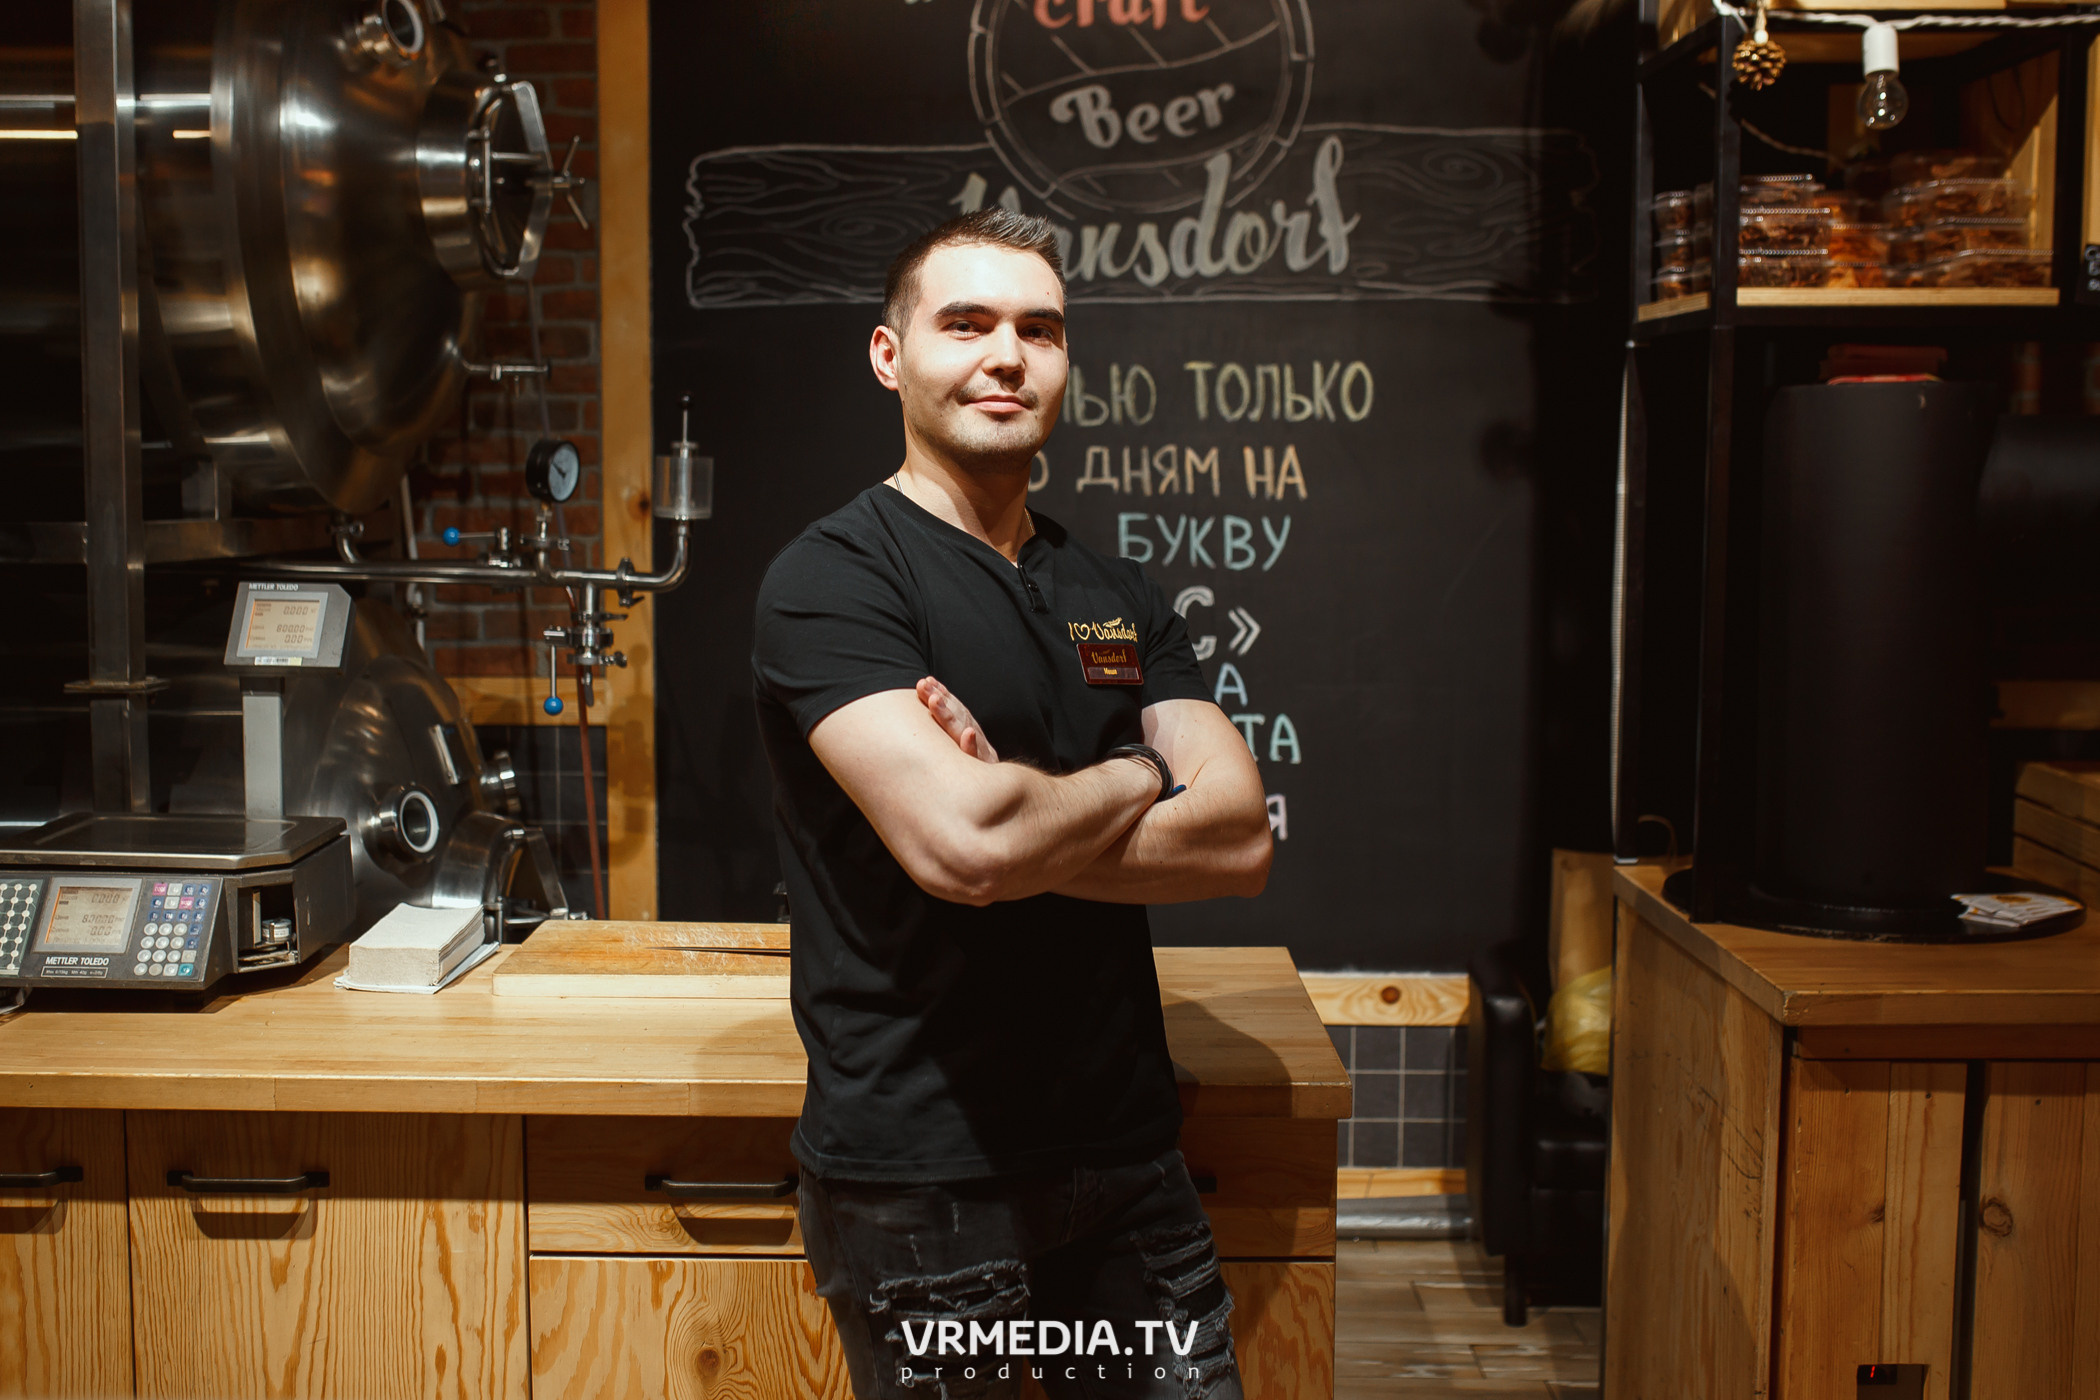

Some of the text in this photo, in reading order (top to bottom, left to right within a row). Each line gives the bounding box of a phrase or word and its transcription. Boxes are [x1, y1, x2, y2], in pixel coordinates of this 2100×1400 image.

[1050, 82, 1235, 149] Beer
[1184, 361, 1374, 421] ТОЛЬКО
[1076, 443, 1221, 497] ДНЯМ
[1243, 444, 1308, 500] НА
[1117, 511, 1292, 572] БУКВУ
[249, 582, 298, 591] METTLER TOLEDO
[45, 956, 110, 966] METTLER TOLEDO
